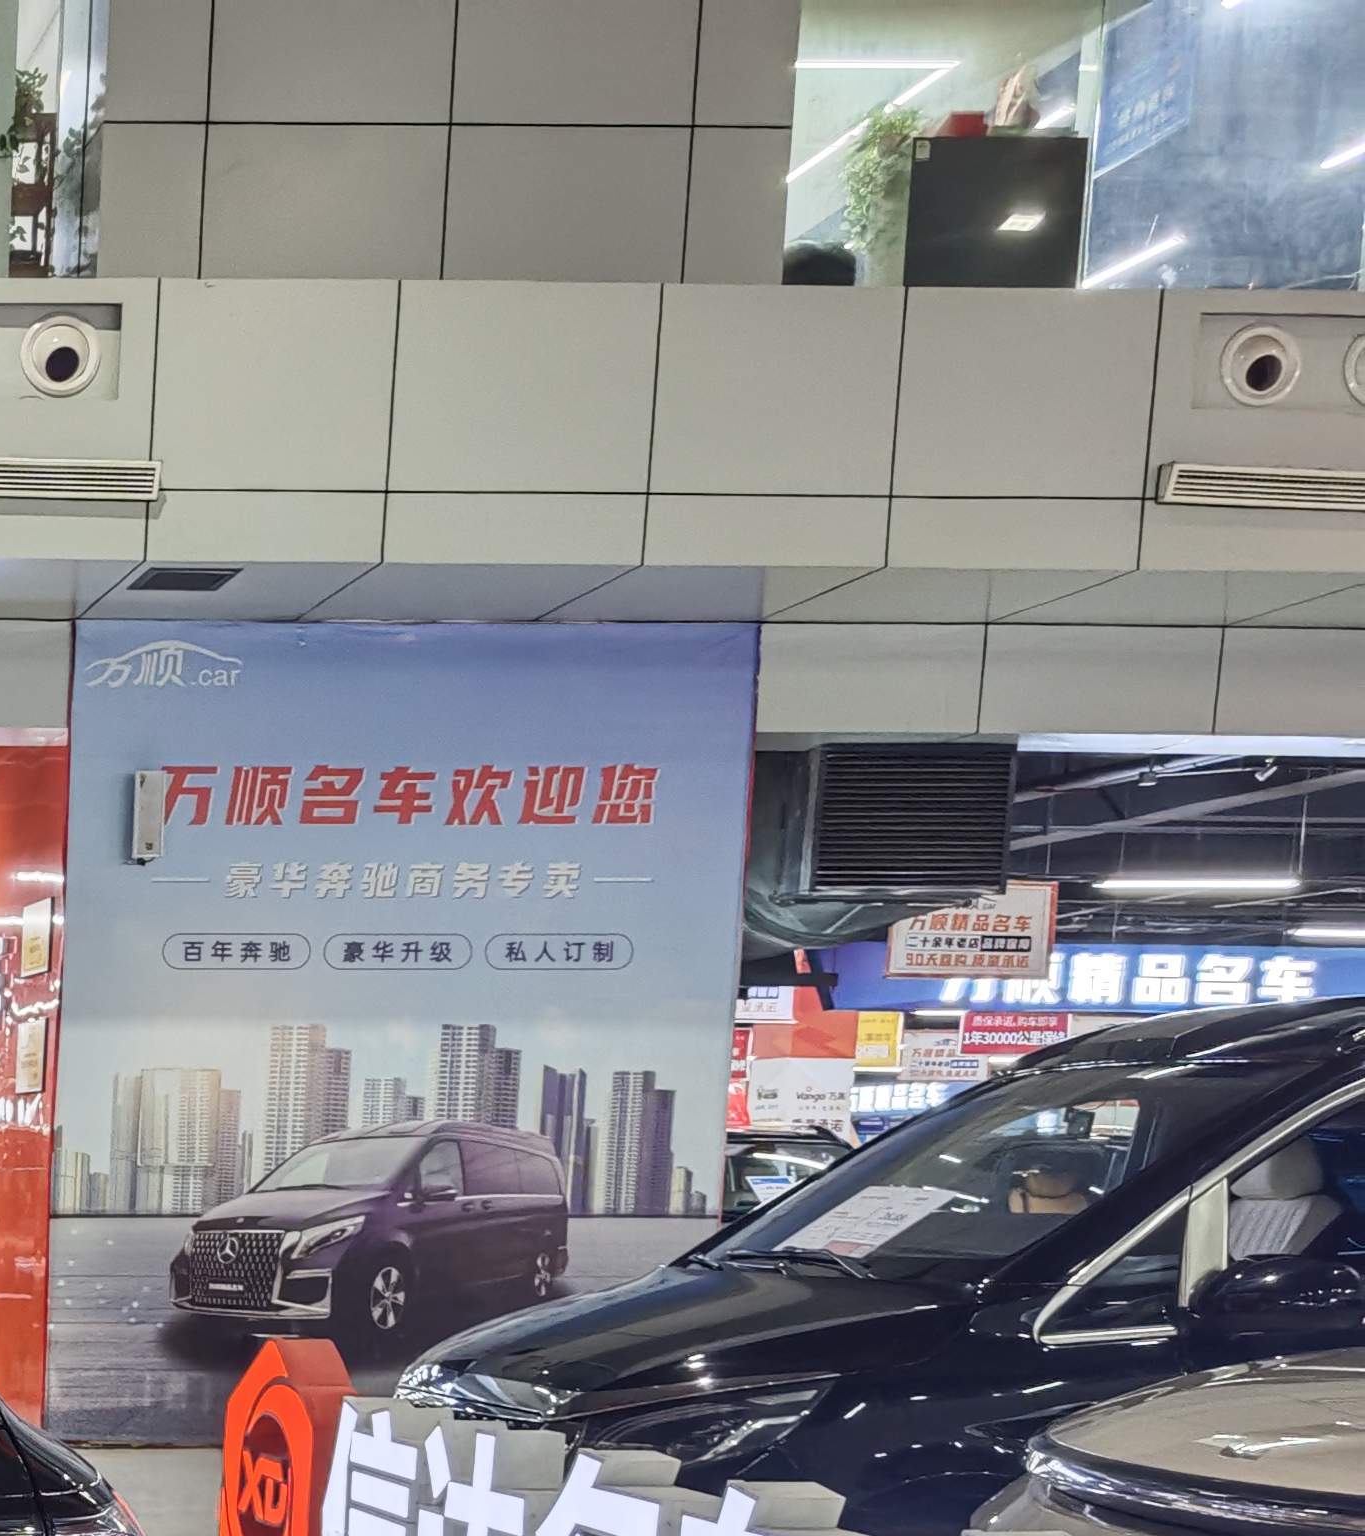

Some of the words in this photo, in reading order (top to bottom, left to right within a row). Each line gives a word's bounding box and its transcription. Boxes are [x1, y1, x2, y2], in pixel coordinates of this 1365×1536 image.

[159, 763, 660, 827] 万顺名车欢迎您
[224, 861, 583, 899] 豪华奔驰商务专卖
[182, 940, 292, 963] 百年奔驰
[342, 940, 453, 963] 豪华升级
[504, 940, 615, 963] 私人订制
